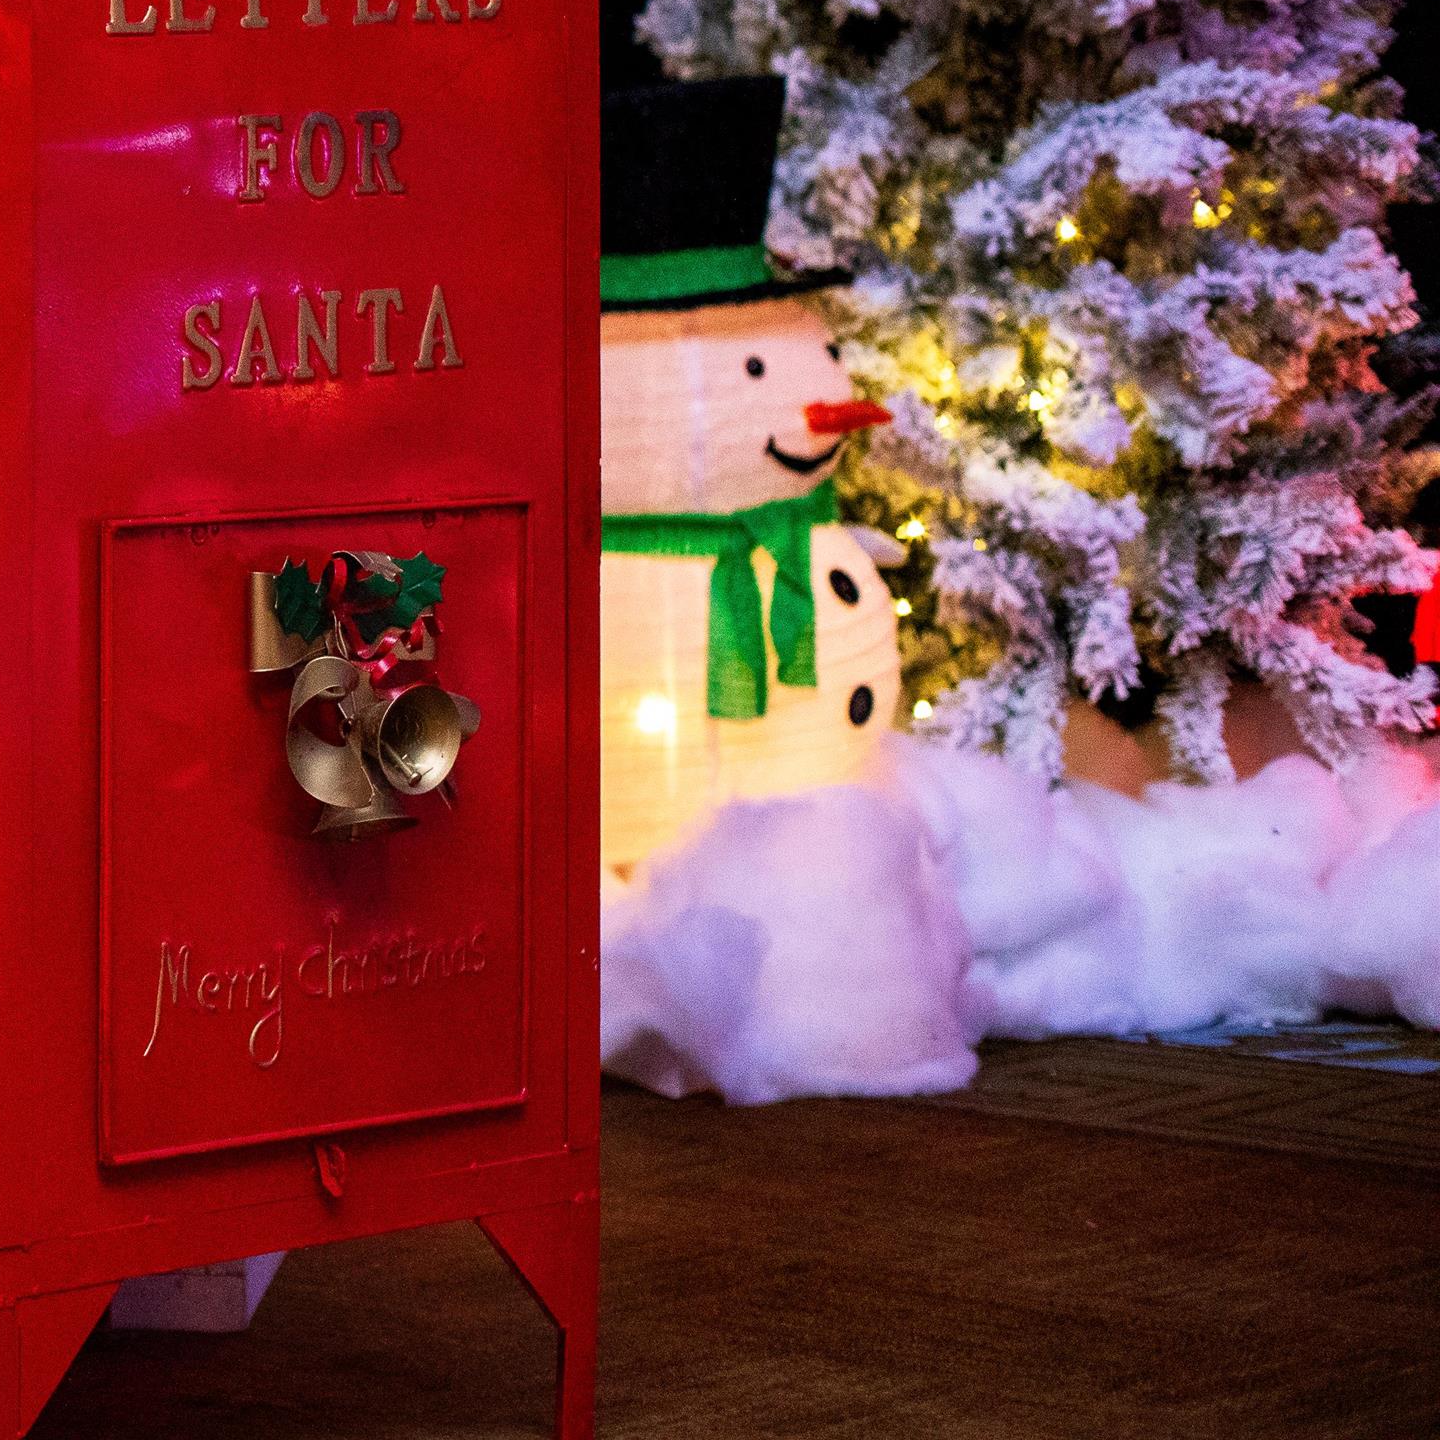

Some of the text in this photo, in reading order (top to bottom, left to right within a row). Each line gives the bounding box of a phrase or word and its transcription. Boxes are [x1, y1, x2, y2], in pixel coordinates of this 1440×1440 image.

[237, 109, 408, 202] FOR
[181, 284, 467, 391] SANTA
[143, 907, 489, 1068] Merry Christmas
